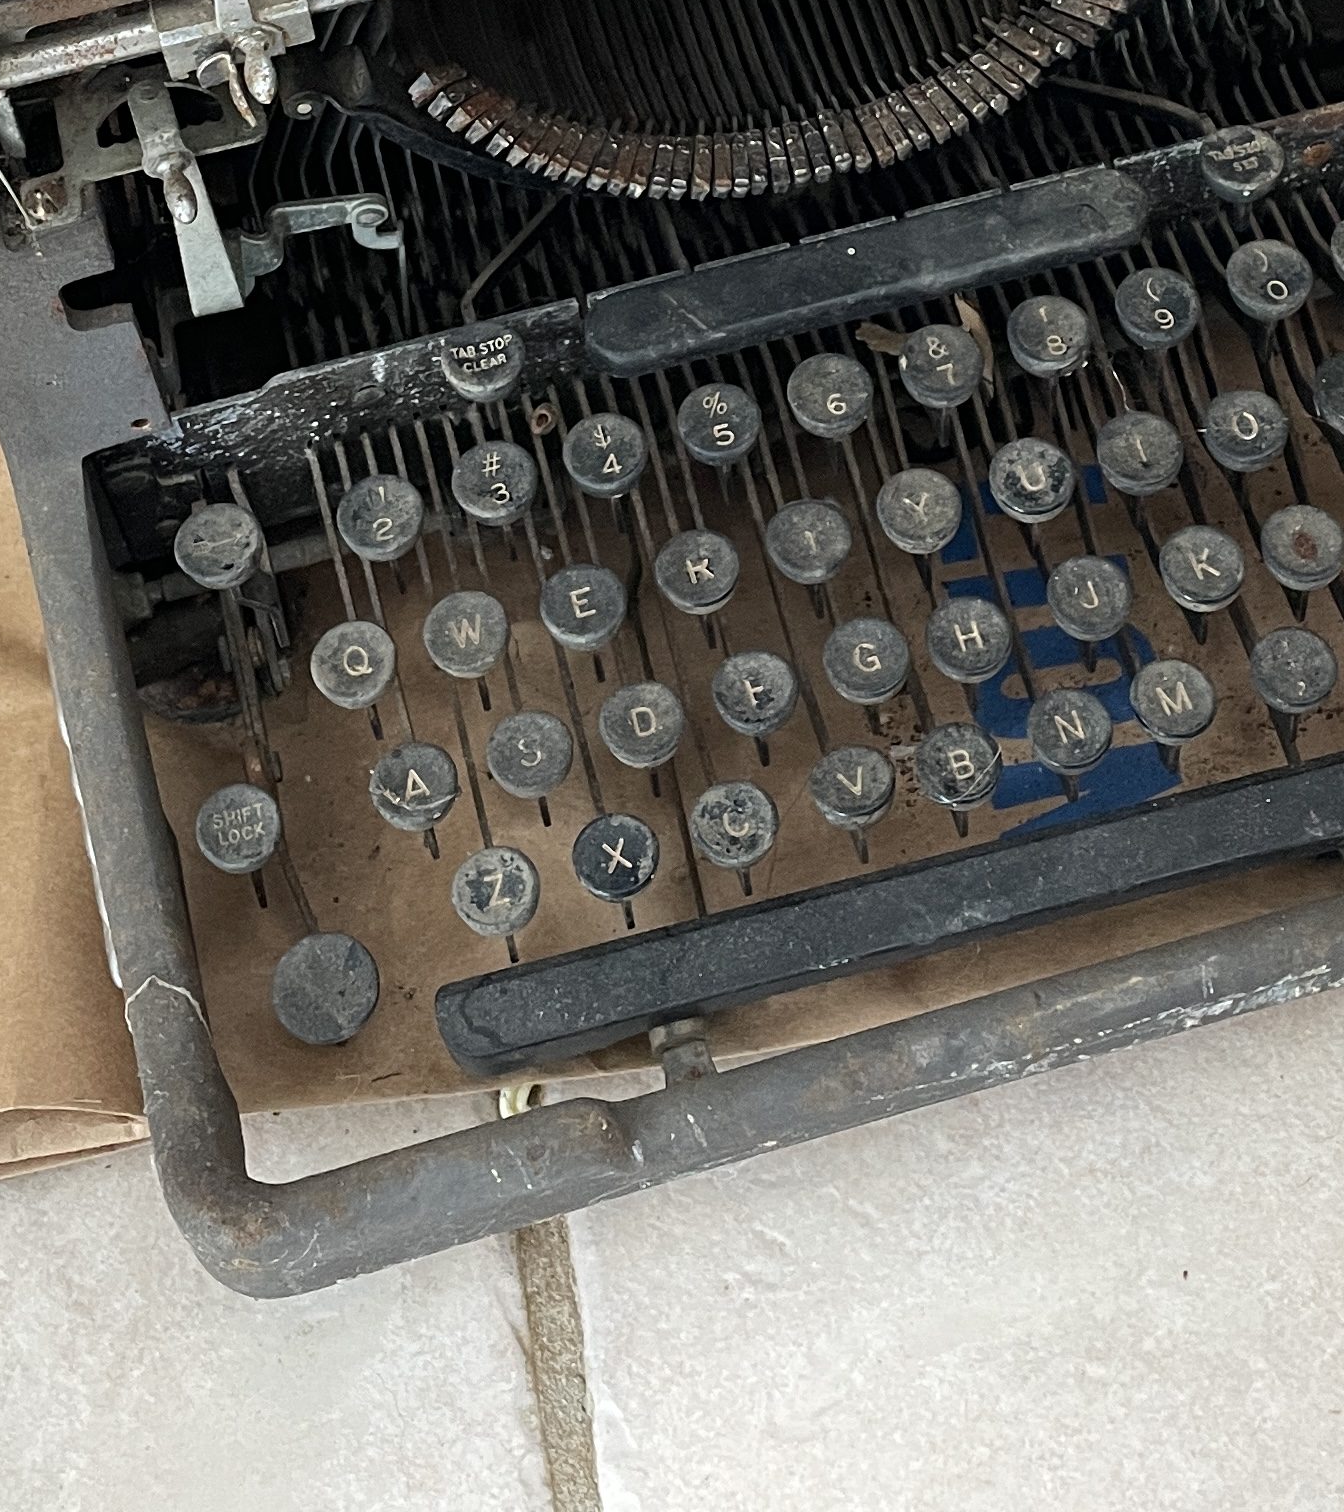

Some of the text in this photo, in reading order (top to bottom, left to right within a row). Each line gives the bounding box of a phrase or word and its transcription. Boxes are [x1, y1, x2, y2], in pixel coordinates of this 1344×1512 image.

[1154, 308, 1176, 330] 9
[450, 334, 513, 361] TAB STOP
[927, 336, 950, 360] &
[1046, 334, 1068, 356] 8
[463, 353, 507, 373] CLEAR
[702, 393, 728, 417] %
[826, 393, 847, 415] 6
[713, 423, 735, 446] 5
[602, 453, 623, 474] 4
[1020, 461, 1047, 491] U
[490, 482, 510, 504] 3
[902, 492, 929, 523] Y
[372, 517, 395, 541] 2
[1189, 547, 1221, 581] K
[569, 587, 594, 619] E
[1083, 580, 1100, 610] J
[453, 614, 483, 648] W
[954, 620, 984, 653] H
[342, 645, 373, 677] Q
[853, 642, 882, 673] G
[1155, 681, 1194, 718] M
[630, 706, 659, 738] D
[1054, 711, 1086, 745] N
[518, 738, 542, 768] S
[948, 748, 975, 781] B
[403, 768, 432, 804] A
[836, 766, 863, 796] V
[212, 803, 264, 829] SHIFT
[216, 821, 266, 847] LOCK
[601, 837, 633, 875] X
[482, 874, 513, 912] Z
